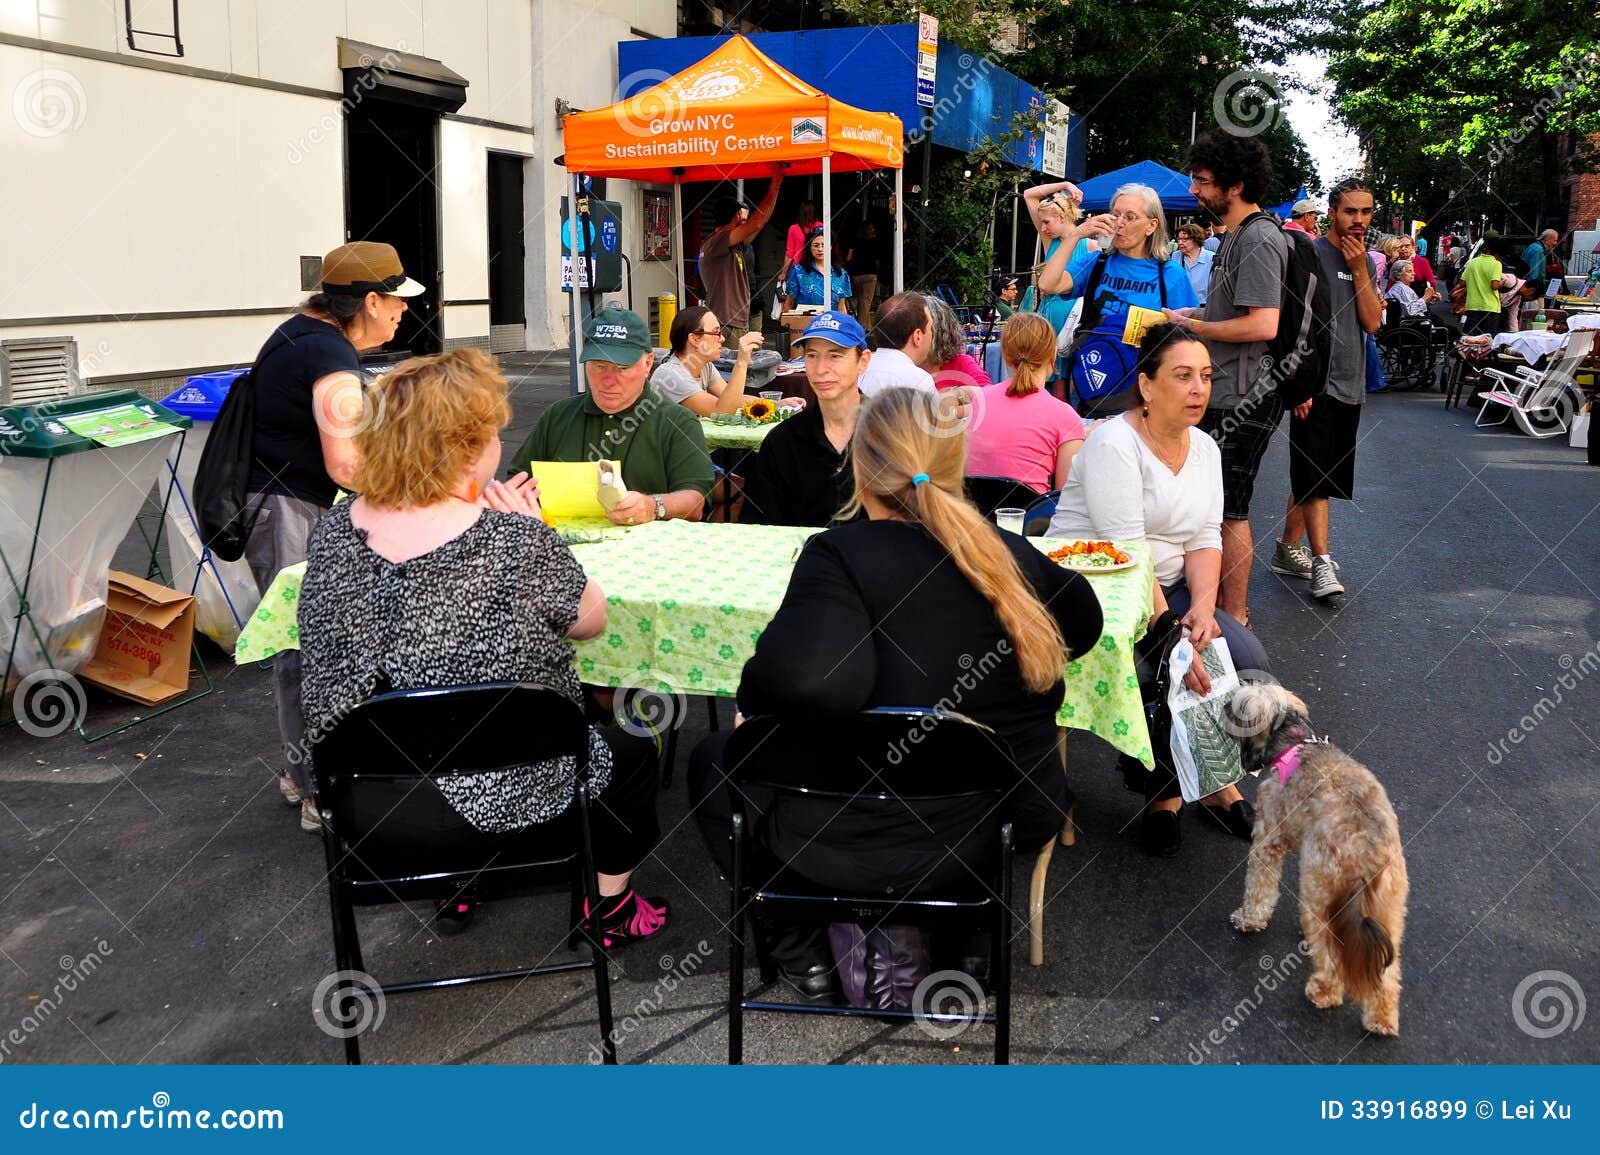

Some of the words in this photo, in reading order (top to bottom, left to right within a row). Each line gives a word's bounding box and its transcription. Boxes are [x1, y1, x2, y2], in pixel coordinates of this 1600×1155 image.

[604, 136, 719, 159] Sustainability
[724, 133, 784, 151] Center
[1101, 272, 1158, 294] OLIDARITY
